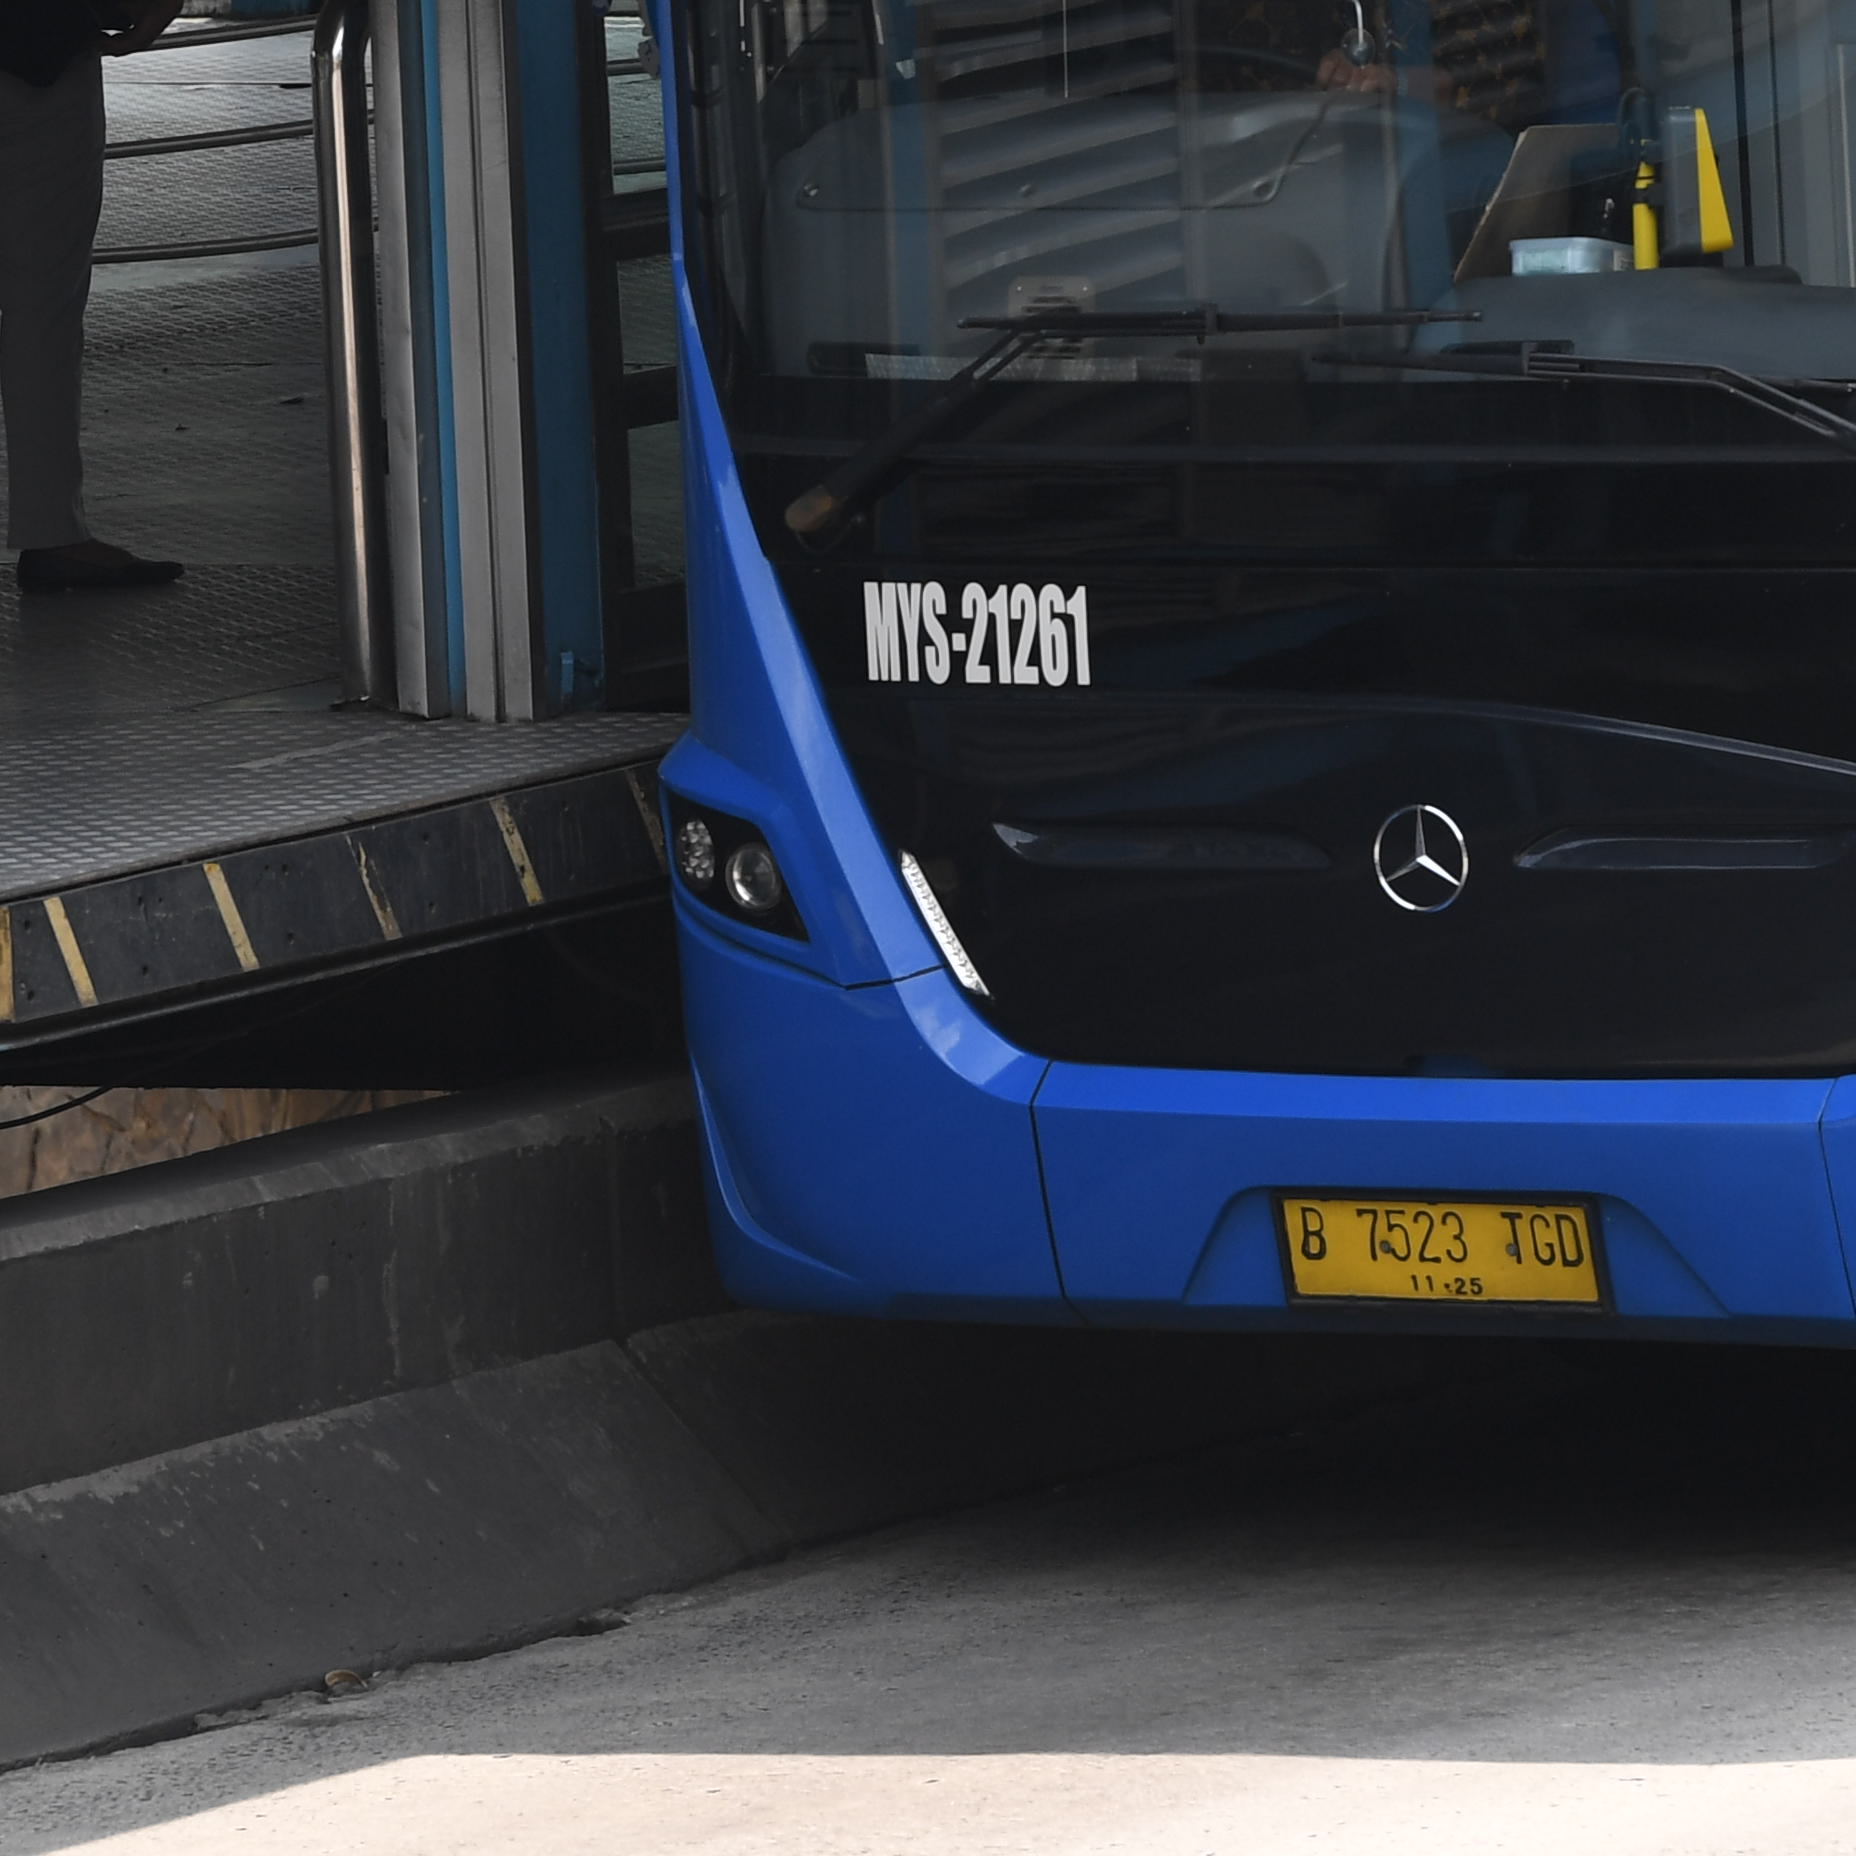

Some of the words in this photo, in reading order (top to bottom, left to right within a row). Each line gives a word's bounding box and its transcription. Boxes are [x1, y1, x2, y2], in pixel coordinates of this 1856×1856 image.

[863, 581, 1091, 686] MYS-21261
[1300, 1206, 1328, 1261] B
[1356, 1208, 1468, 1263] 7523
[1500, 1211, 1584, 1268] TGD
